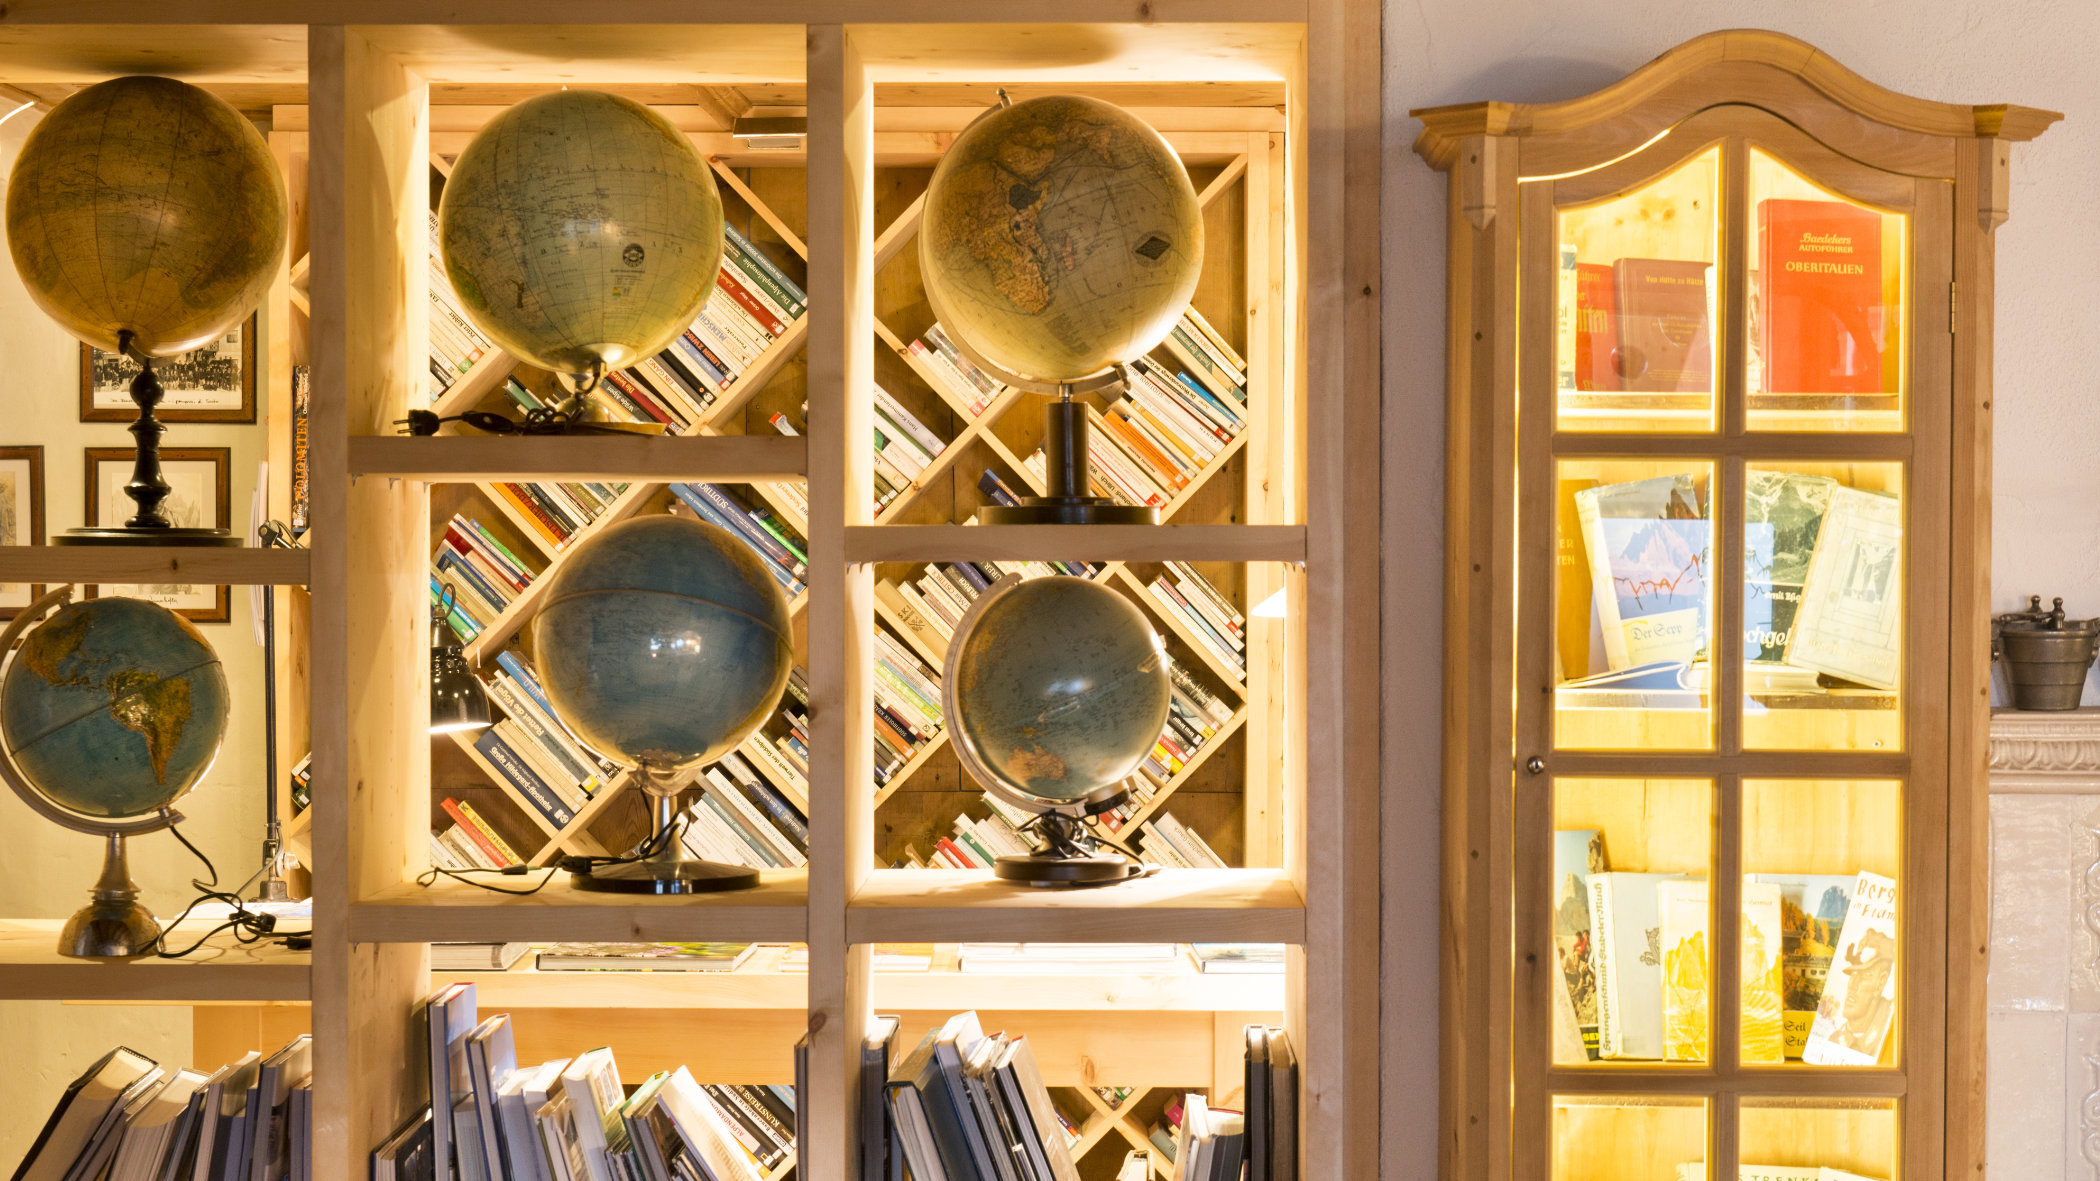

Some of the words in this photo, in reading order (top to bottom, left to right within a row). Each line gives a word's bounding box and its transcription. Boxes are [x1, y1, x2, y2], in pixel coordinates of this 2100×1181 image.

[1800, 231, 1851, 245] Baedekers
[1785, 260, 1863, 275] OBERITALIEN
[295, 417, 307, 499] DOLOMITEN
[511, 702, 525, 716] die
[520, 712, 545, 736] Rettet
[488, 746, 508, 764] Große
[777, 762, 796, 780] Tierwelt
[1783, 1020, 1806, 1033] Seil
[742, 1087, 781, 1129] KUNSTREISE
